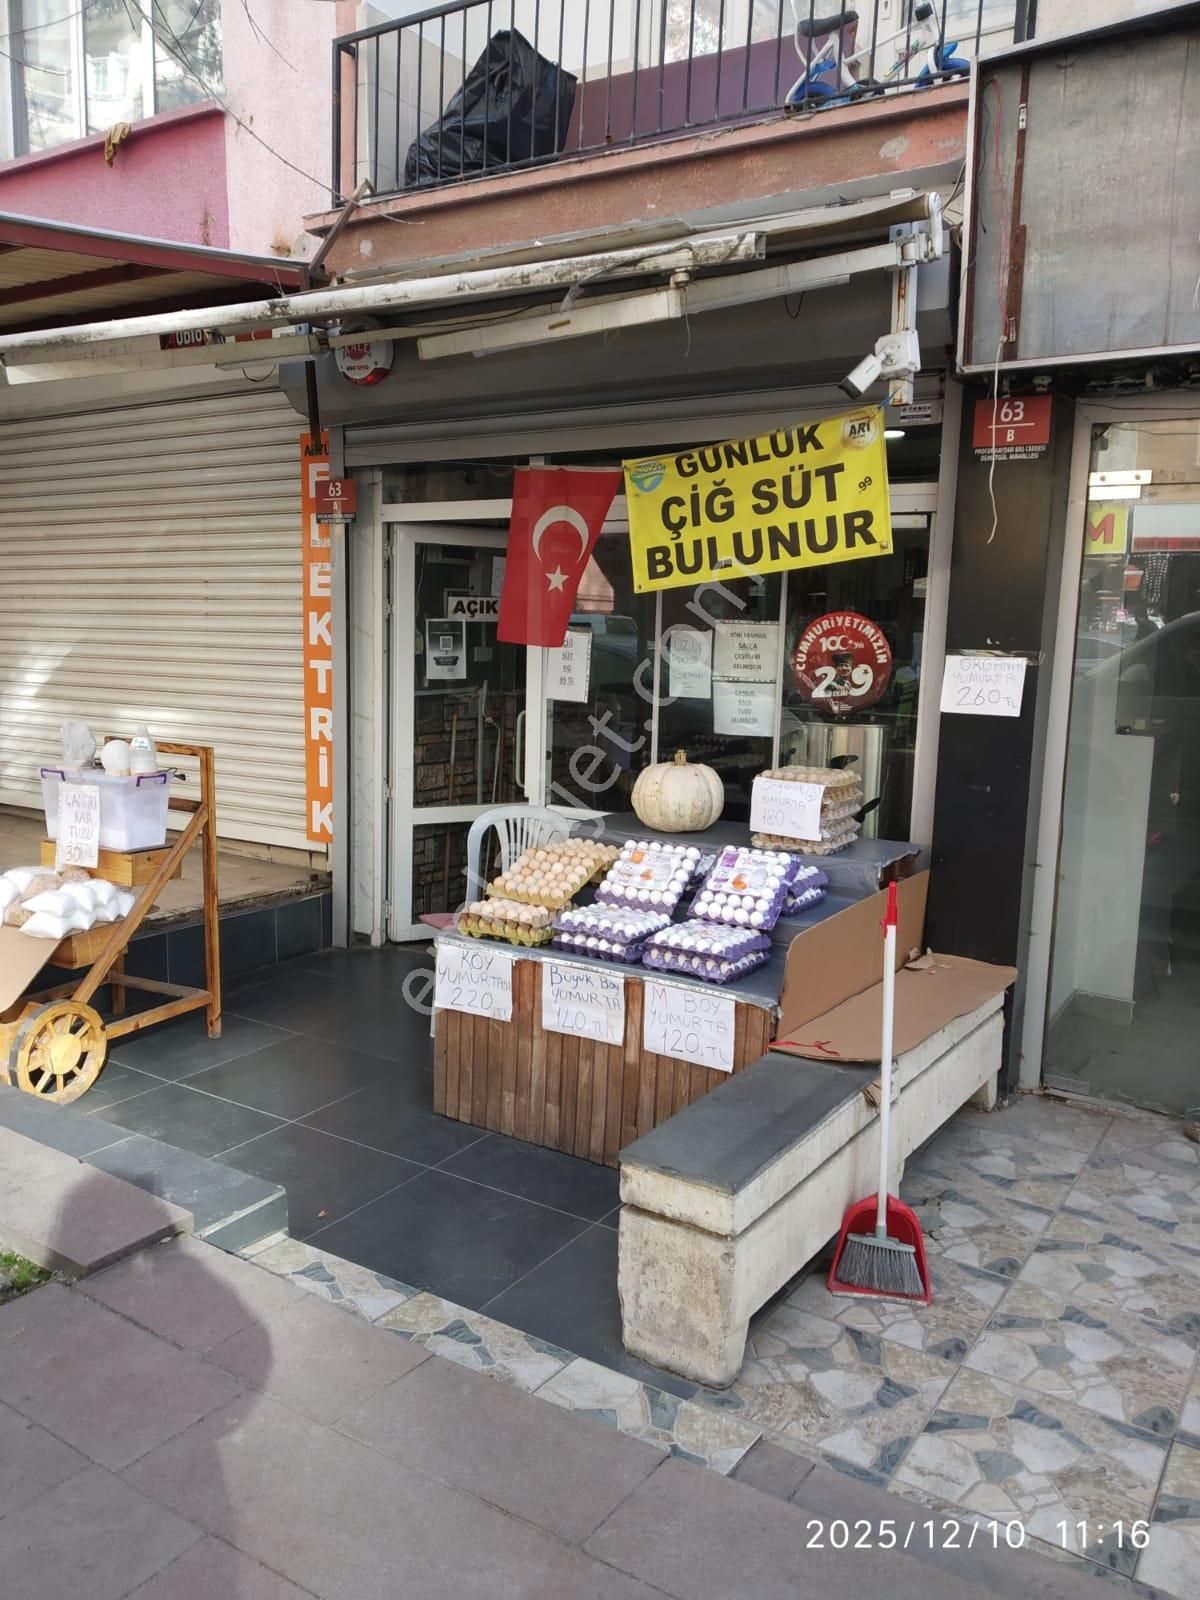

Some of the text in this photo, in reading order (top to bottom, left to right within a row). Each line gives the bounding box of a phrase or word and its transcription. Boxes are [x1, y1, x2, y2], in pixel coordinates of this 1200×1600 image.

[1000, 401, 1025, 422] 63
[1006, 429, 1015, 442] B
[328, 482, 342, 497] 63
[332, 502, 338, 510] A
[661, 463, 845, 540] ÇİĞ SÜT
[646, 509, 878, 581] BULUNUR
[453, 600, 499, 618] AÇIK
[796, 616, 888, 671] CUMHURİYETİMİZİN
[956, 686, 1001, 706] 260
[650, 986, 722, 1017] M BOY
[650, 1008, 729, 1033] YUMURTA
